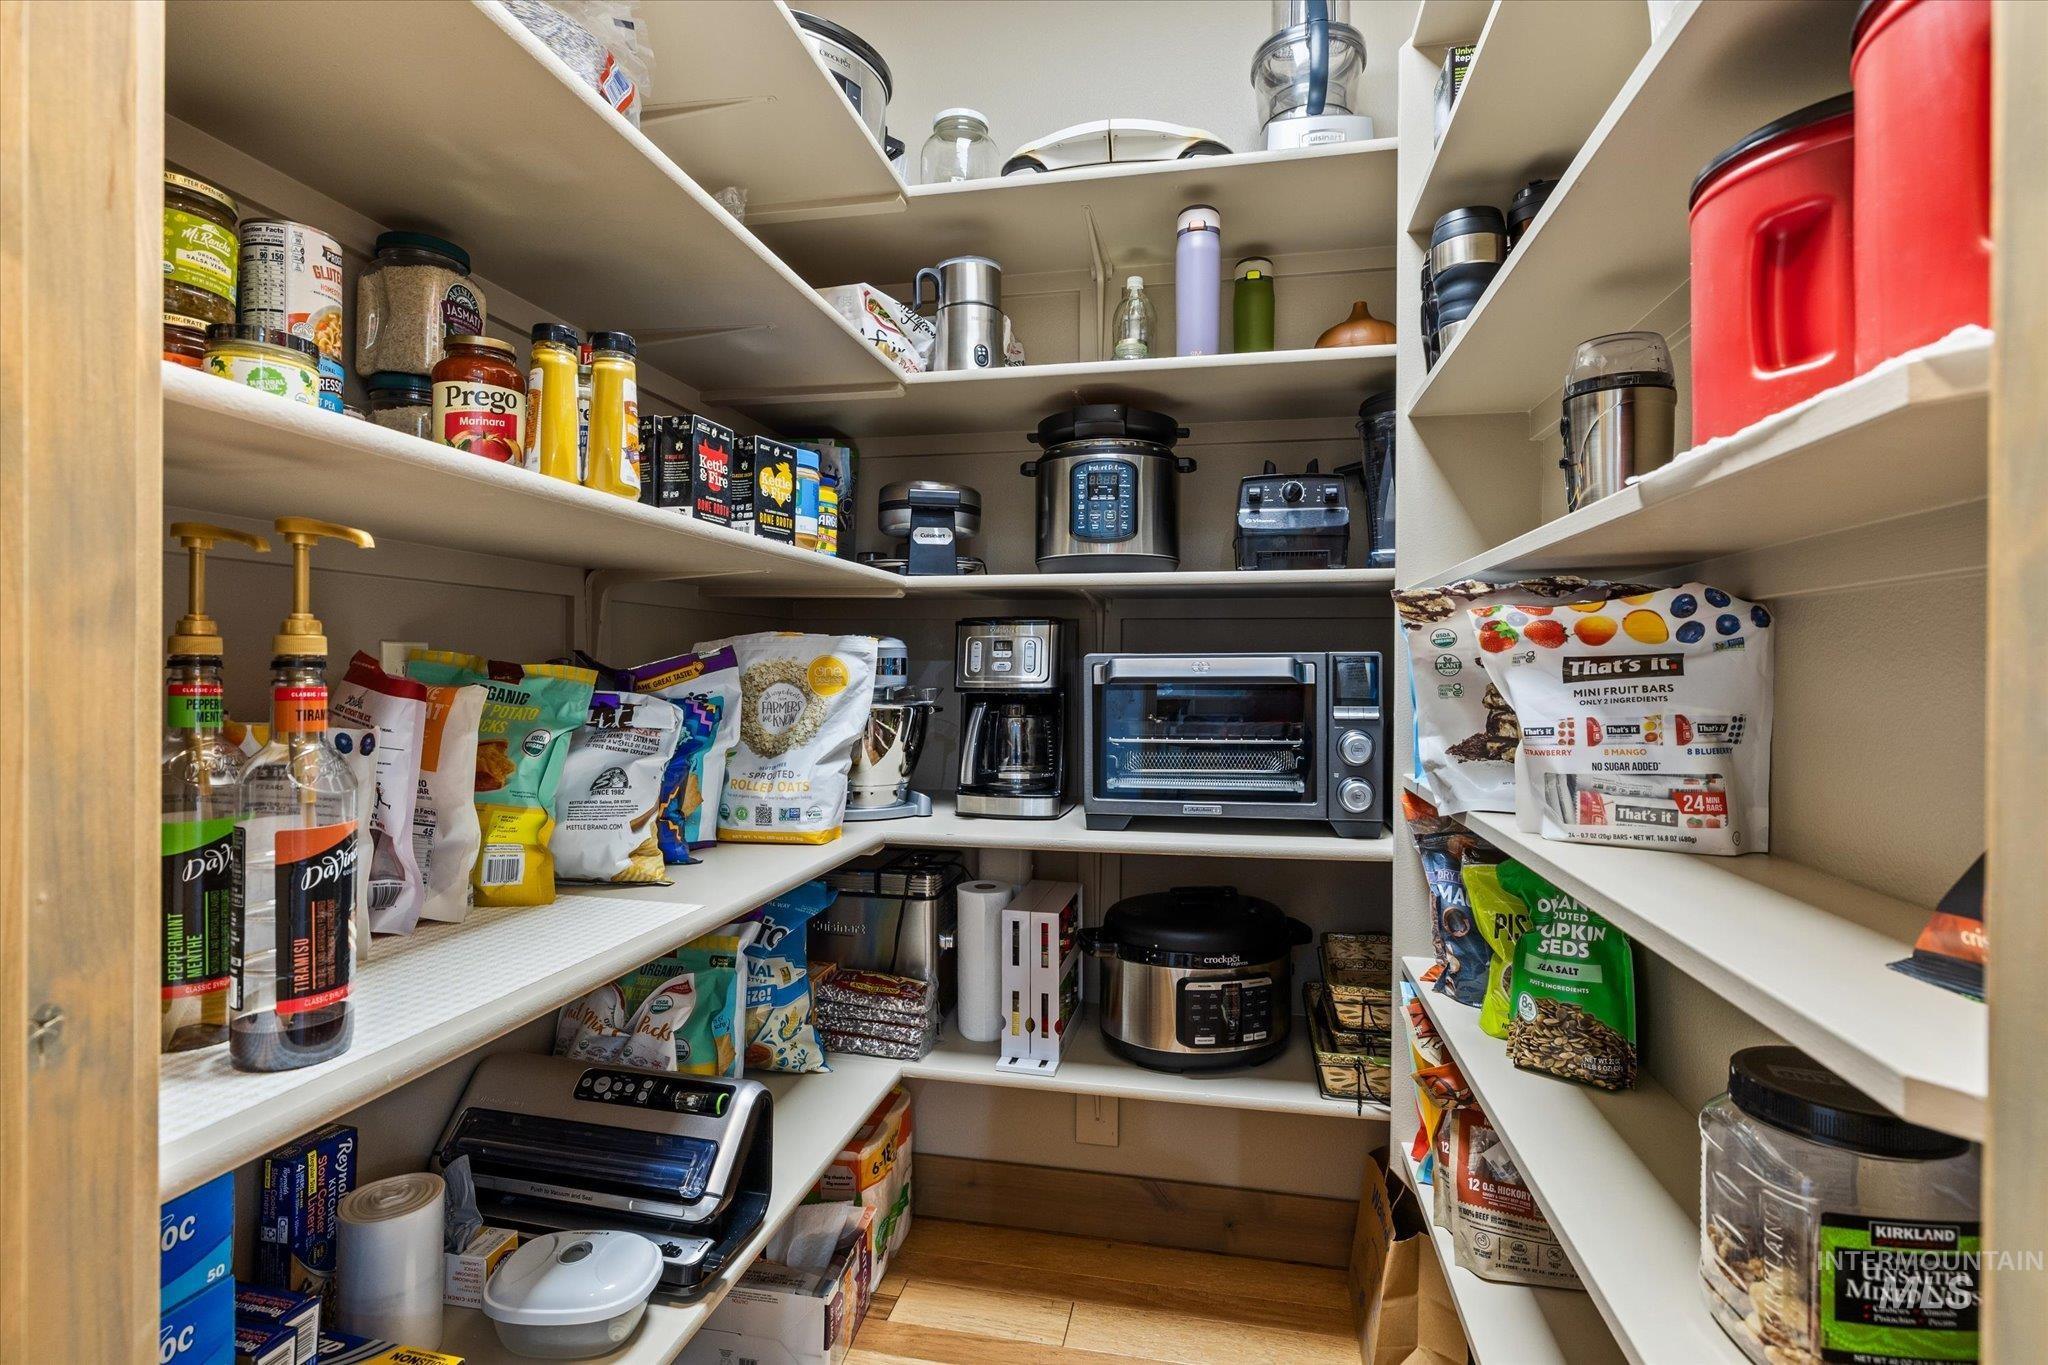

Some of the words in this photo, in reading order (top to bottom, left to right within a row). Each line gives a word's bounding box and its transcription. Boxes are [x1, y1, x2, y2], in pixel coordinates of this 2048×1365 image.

[265, 226, 285, 235] Facts
[181, 226, 199, 244] Mi
[199, 229, 232, 255] Rancho
[185, 253, 208, 267] SALSA
[210, 261, 228, 274] VERDE
[259, 251, 268, 259] 90
[271, 252, 284, 261] 150
[163, 314, 203, 329] EFRIGERATE
[446, 303, 482, 331] JASMATI
[324, 398, 336, 412] PEA
[445, 384, 518, 415] Prego
[459, 415, 506, 428] Marinara
[698, 453, 729, 476] Kettle
[699, 467, 708, 482] &
[708, 470, 729, 489] Fire
[761, 472, 792, 490] Kettle
[770, 486, 792, 503] Fire
[697, 498, 712, 514] BONE
[713, 502, 730, 518] BROTH
[759, 511, 775, 525] BONE
[776, 516, 793, 530] BROTH
[1568, 657, 1641, 677] That's
[1650, 657, 1678, 672] it.
[652, 675, 672, 688] GREAT
[673, 669, 693, 681] TASTE!
[486, 685, 531, 706] GANIC
[1573, 687, 1601, 698] MINI
[1603, 685, 1637, 696] FRUIT
[1641, 683, 1675, 694] BARS
[761, 700, 803, 715] FARMERS
[1579, 698, 1603, 706] ONLY
[1610, 695, 1669, 704] INGREDIENTS
[491, 704, 540, 721] POTATO
[762, 713, 773, 723] we
[772, 713, 798, 728] KNOW
[634, 728, 660, 737] SALT
[1524, 728, 1545, 736] That's
[1607, 726, 1629, 734] That's
[1699, 724, 1719, 733] That's
[633, 734, 648, 744] EXTRA
[648, 736, 661, 746] MILE
[605, 745, 628, 753] SNACKING
[640, 744, 659, 752] FLAVOR
[1611, 748, 1648, 756] MANGO
[1686, 748, 1693, 756] 8
[1694, 747, 1734, 756] BLUEBERRY
[1591, 762, 1603, 771] NO
[1604, 762, 1630, 772] SUGAR
[747, 770, 795, 781] SPROUTED
[730, 778, 774, 793] ROLLED
[777, 780, 811, 793] OATS
[1682, 794, 1706, 812] 24
[1705, 796, 1720, 804] MINI
[1705, 803, 1724, 812] BARS
[419, 808, 437, 817] Facts
[1617, 807, 1657, 823] That's
[1660, 810, 1673, 824] it
[422, 827, 434, 837] 45
[565, 823, 624, 832] KETTLEBRAND.COM
[1598, 833, 1612, 841] (20g)
[1612, 833, 1628, 841] BARS
[1678, 835, 1698, 844] (480g)
[1437, 869, 1456, 880] DRY
[167, 912, 184, 981] PEPPERMINT
[186, 933, 203, 979] MENTHE
[1203, 953, 1241, 966] crockpot
[293, 937, 310, 994] TIRAMISU
[640, 963, 685, 978] ORGANIC
[1537, 962, 1554, 972] SEA
[1555, 964, 1579, 976] SALT
[185, 983, 212, 995] CLASSIC
[1529, 978, 1541, 987] JUST
[1545, 983, 1590, 994] INGREDIENTS
[303, 994, 329, 1008] CLASSIC
[1521, 995, 1533, 1011] 8g
[636, 1015, 674, 1042] Packs
[1440, 1140, 1450, 1154] 12
[308, 1152, 317, 1179] Regular
[317, 1155, 328, 1187] Slow
[334, 1137, 354, 1200] Reynol
[283, 1167, 291, 1196] Reynolds
[1467, 1177, 1481, 1192] 12
[530, 1185, 544, 1194] Push
[550, 1189, 571, 1198] Vacuum
[571, 1191, 581, 1200] and
[581, 1193, 594, 1202] Seal
[1482, 1182, 1497, 1194] O.G.
[1497, 1185, 1532, 1201] HICKORY
[270, 1189, 278, 1220] Cooker
[316, 1188, 328, 1234] Cooker
[326, 1177, 337, 1240] KITCHENS
[307, 1195, 318, 1237] Liners
[1475, 1211, 1490, 1221] BEEF
[1875, 1225, 1957, 1242] KIRKLAND
[206, 1263, 226, 1285] 50
